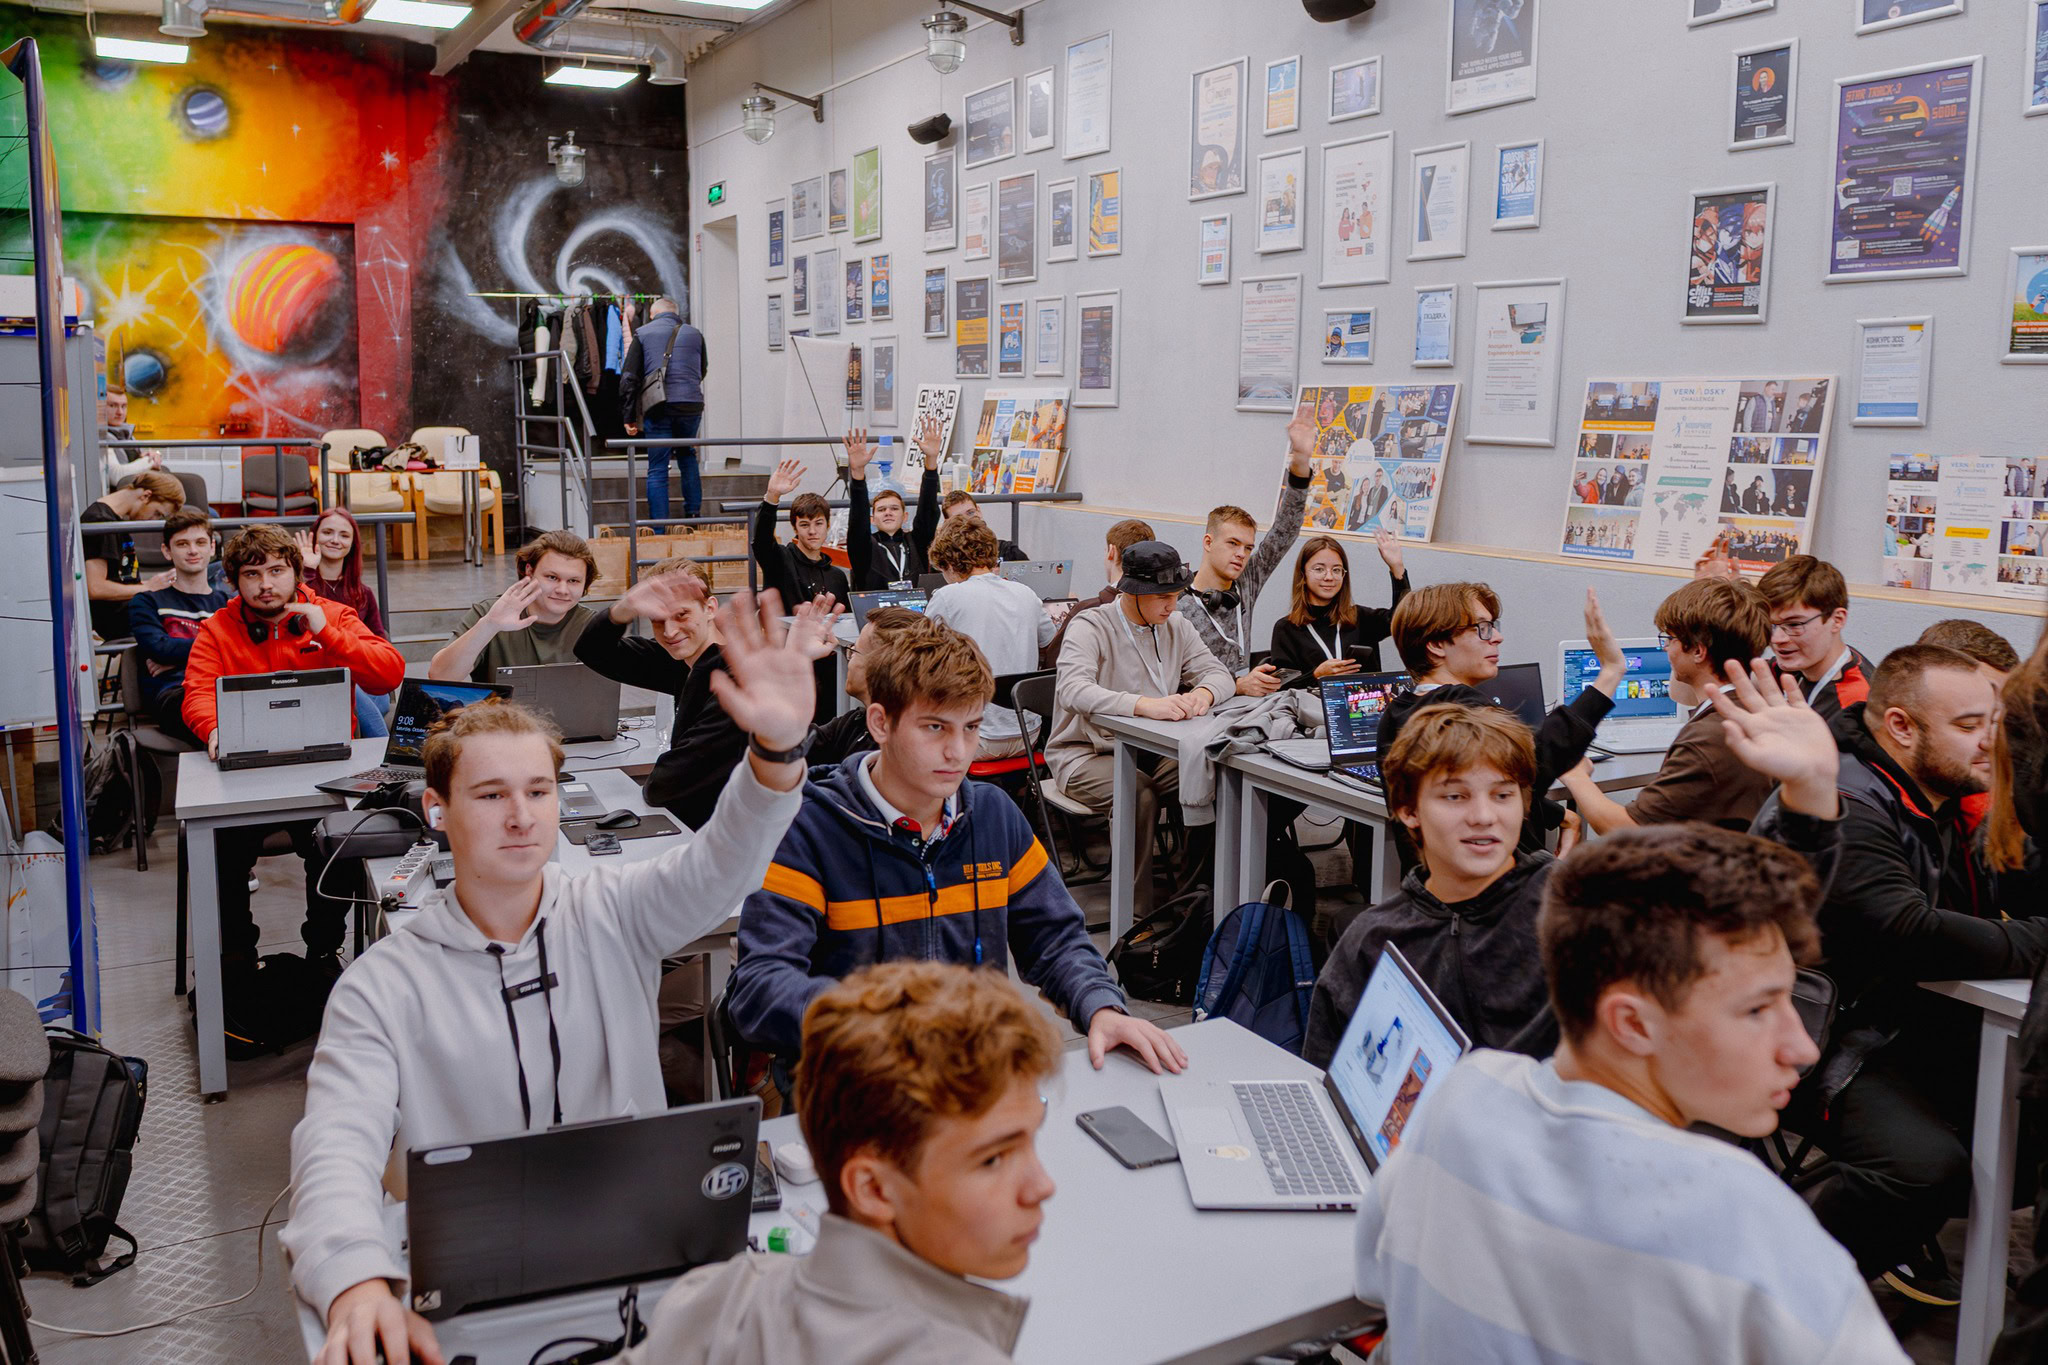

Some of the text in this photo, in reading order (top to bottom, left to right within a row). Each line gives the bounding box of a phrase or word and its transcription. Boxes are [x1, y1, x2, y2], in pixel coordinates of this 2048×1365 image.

[1741, 56, 1751, 66] 14
[1845, 88, 1866, 103] STAR
[1932, 104, 1957, 120] 5000
[1688, 285, 1713, 297] CHILL
[1688, 296, 1710, 307] CUP
[1423, 312, 1447, 320] ПОДЯКА
[397, 715, 415, 726] 9:08
